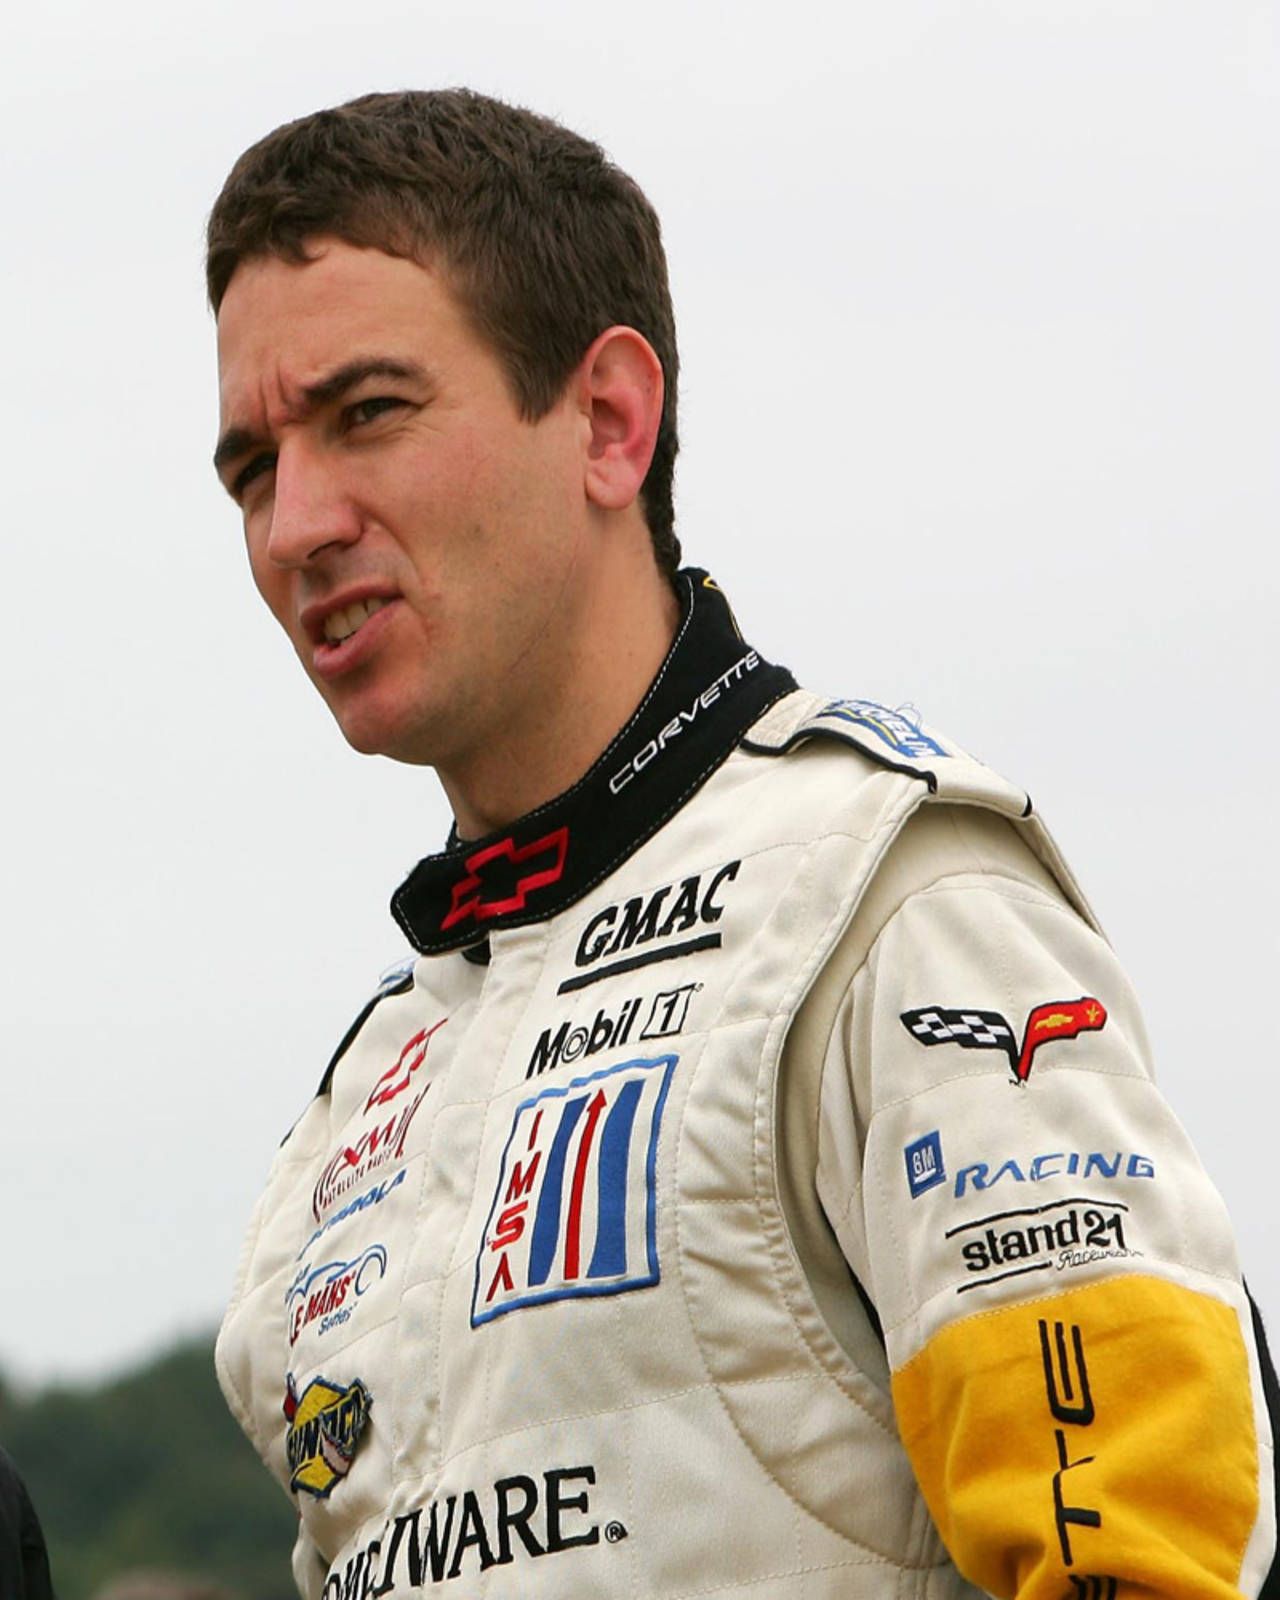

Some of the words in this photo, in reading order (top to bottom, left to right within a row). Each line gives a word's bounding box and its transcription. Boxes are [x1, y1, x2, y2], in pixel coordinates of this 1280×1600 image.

[609, 650, 760, 795] CORVETTE
[575, 859, 742, 967] GMAC
[525, 998, 643, 1080] Mobil
[911, 1144, 937, 1178] GM
[954, 1152, 1155, 1199] RACING
[484, 1108, 544, 1303] IMSA
[302, 1272, 353, 1329] MANS
